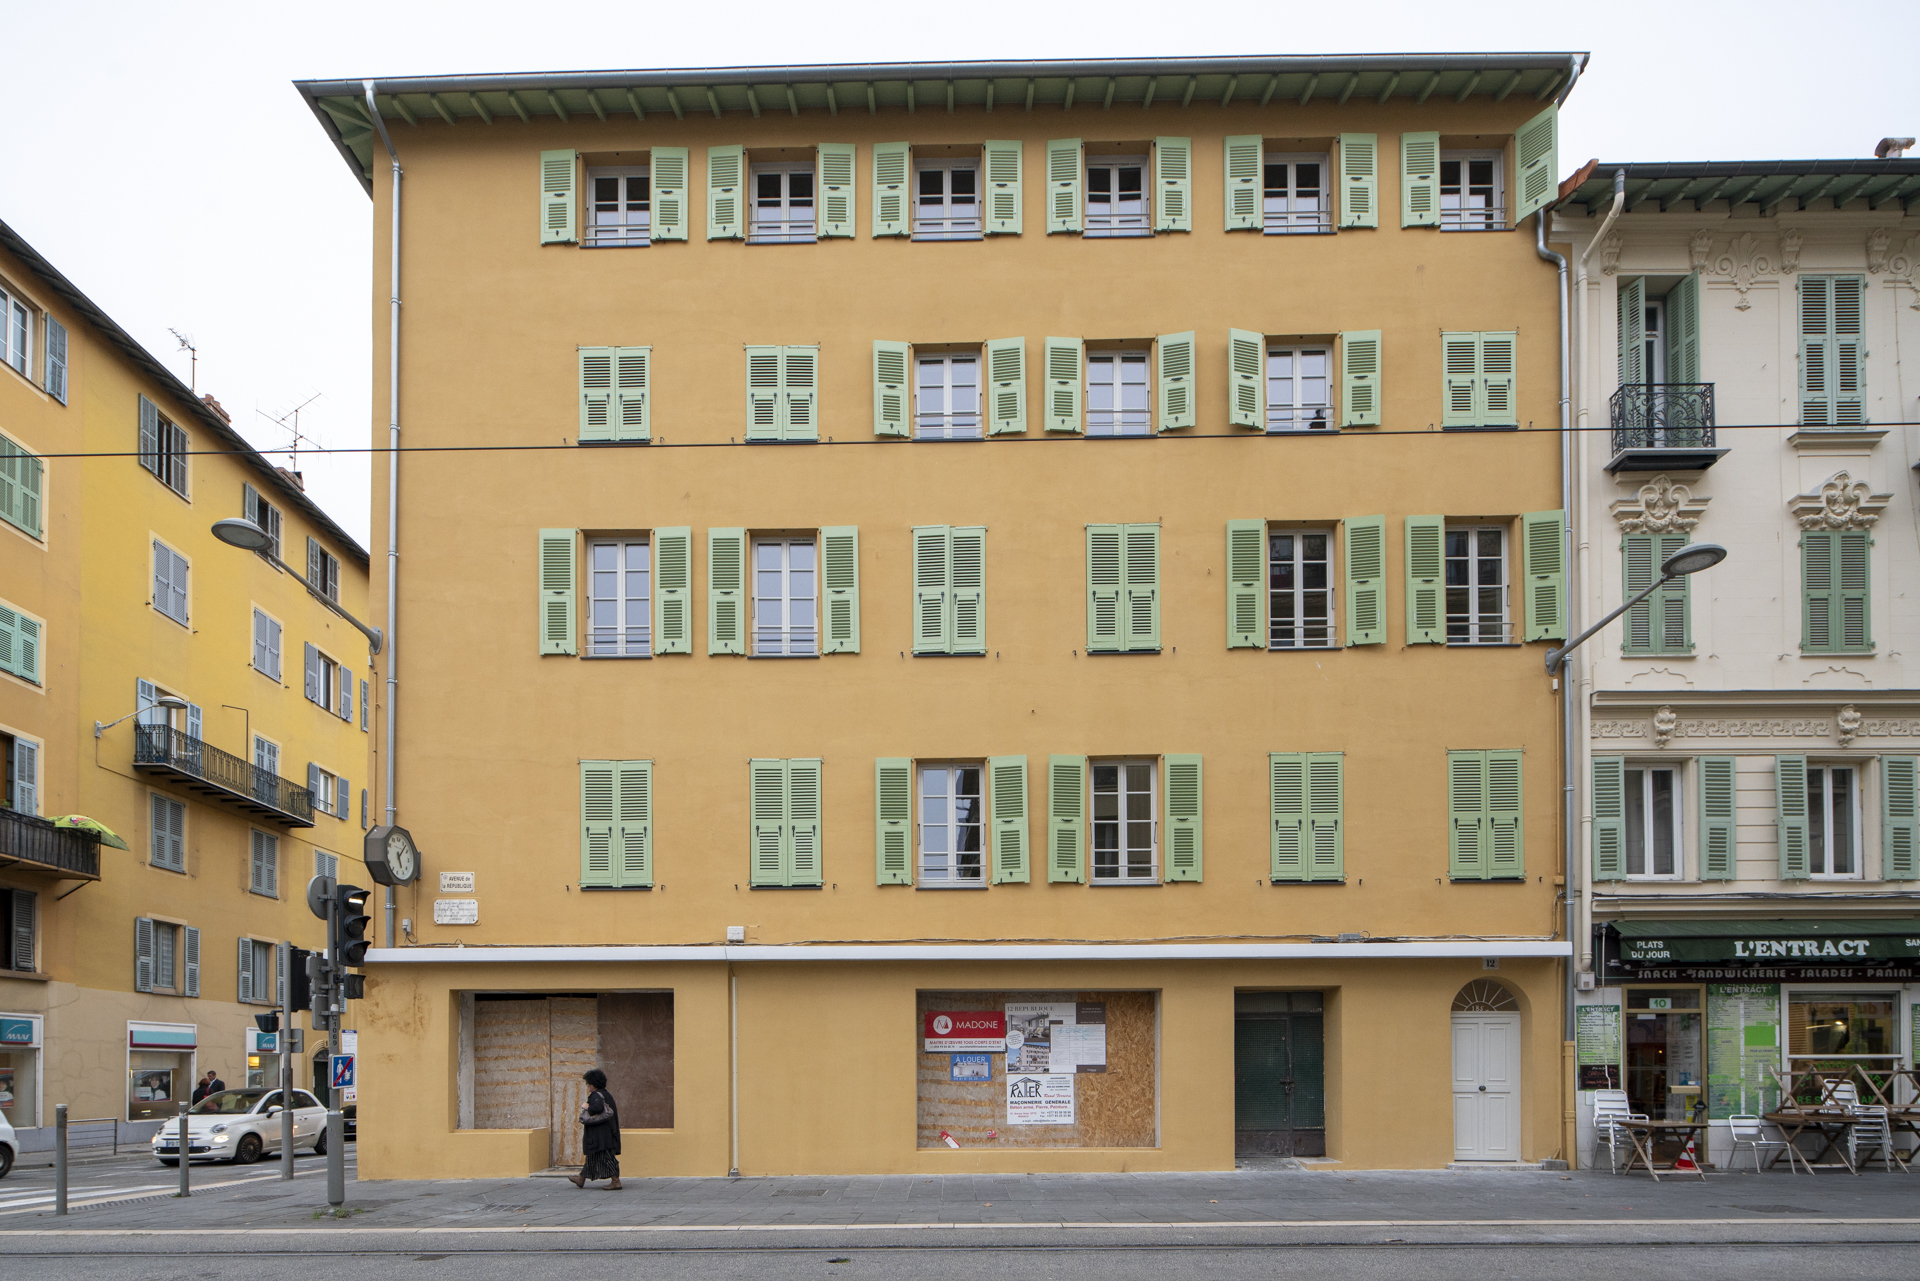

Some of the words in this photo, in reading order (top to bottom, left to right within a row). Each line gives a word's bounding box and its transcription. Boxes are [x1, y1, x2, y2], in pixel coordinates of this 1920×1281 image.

[1734, 940, 1870, 957] L'ENTRACT
[1486, 959, 1495, 967] 12
[1638, 970, 1677, 978] SNACK
[1691, 969, 1786, 978] SANDWICHERIE
[1800, 969, 1853, 978] SALADES
[1867, 968, 1912, 977] PANINI
[1654, 999, 1667, 1008] 10
[956, 1021, 998, 1029] MADONE
